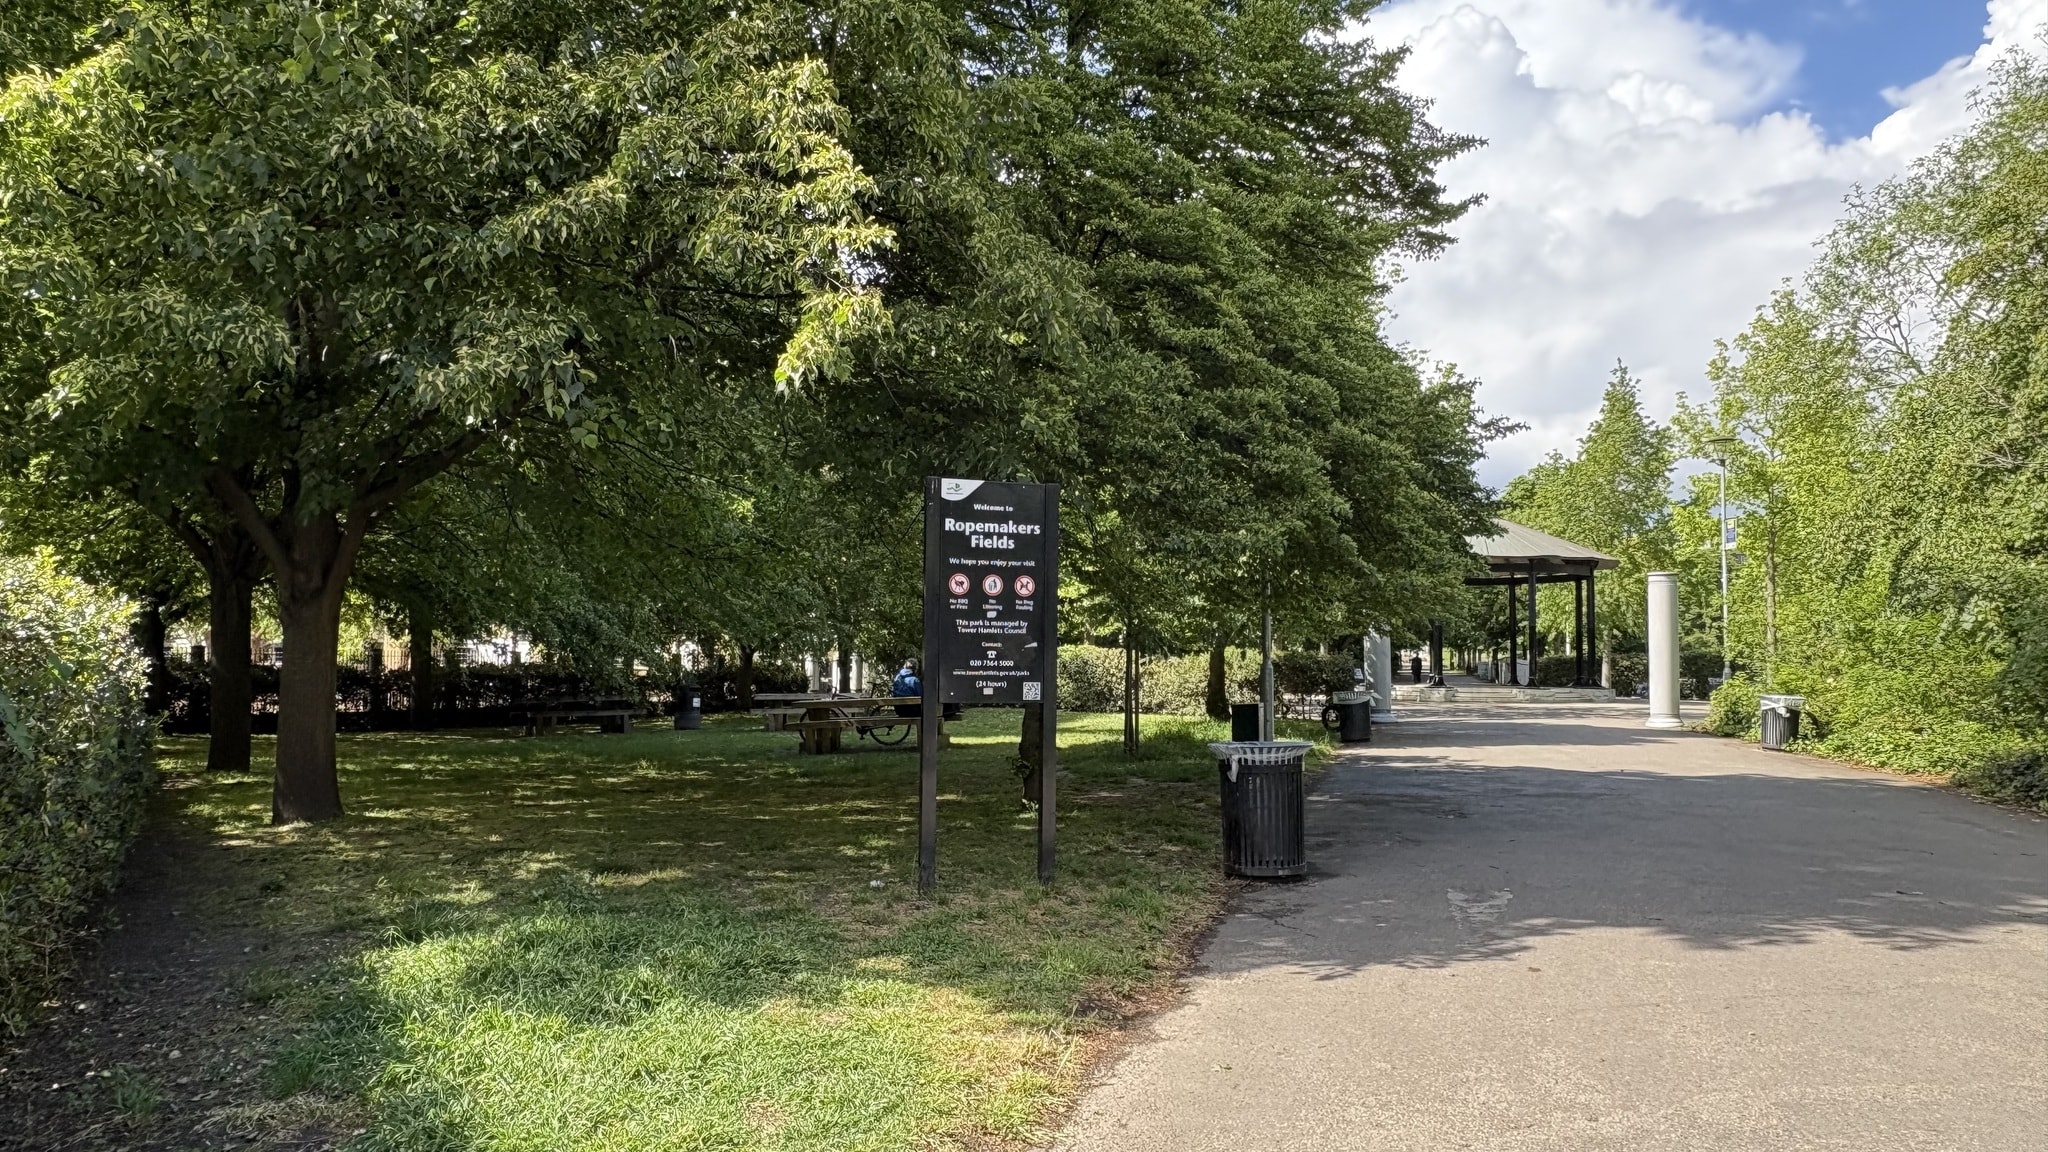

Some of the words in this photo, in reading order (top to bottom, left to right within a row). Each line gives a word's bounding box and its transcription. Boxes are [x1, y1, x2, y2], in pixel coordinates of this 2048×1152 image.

[973, 503, 1004, 512] Welcome
[944, 517, 1041, 535] Ropemakers
[970, 534, 1015, 550] Fields
[949, 557, 960, 565] We
[960, 557, 977, 566] hope
[990, 558, 1007, 567] enjoy
[1022, 559, 1036, 567] visit
[969, 619, 984, 628] park
[990, 620, 1019, 628] managed
[1020, 620, 1028, 628] by
[957, 626, 977, 634] Tower
[978, 626, 1003, 634] Hamlets
[969, 659, 982, 667] 020
[975, 680, 987, 688] (24
[987, 680, 1008, 688] hours)
